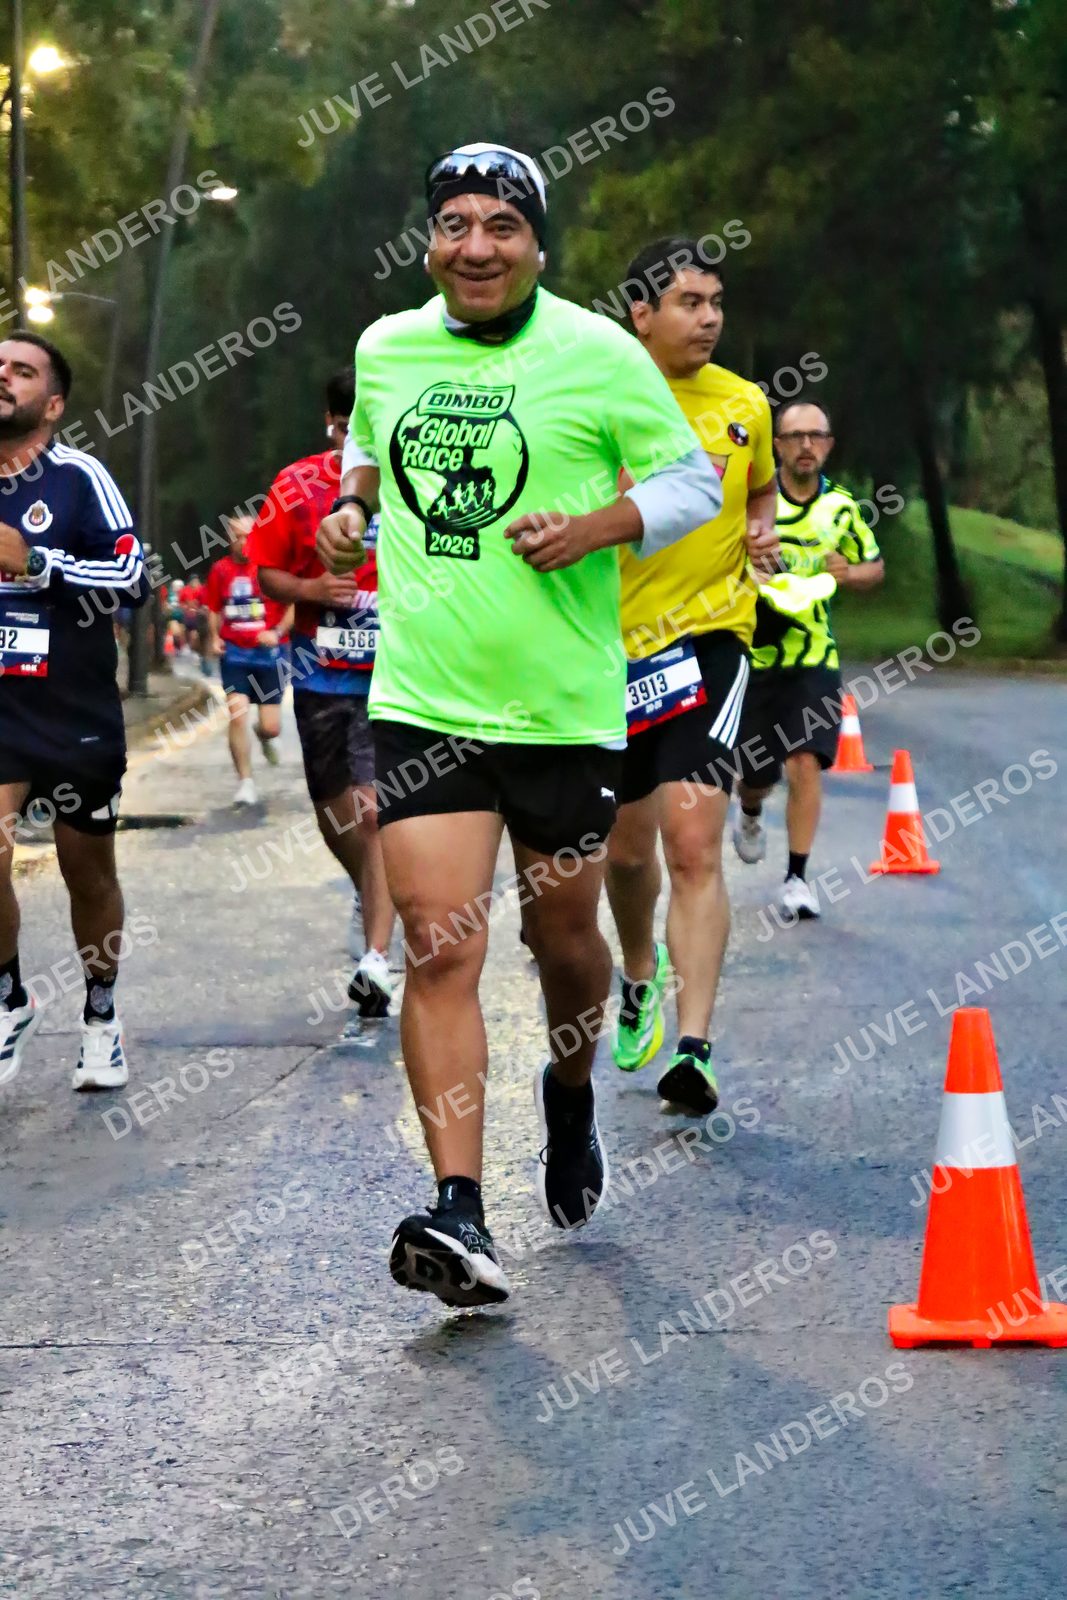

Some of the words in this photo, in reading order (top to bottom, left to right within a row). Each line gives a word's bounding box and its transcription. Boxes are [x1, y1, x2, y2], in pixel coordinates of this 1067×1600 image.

[427, 392, 504, 410] BIMBO
[419, 417, 496, 448] Global
[402, 439, 464, 472] Race
[429, 532, 475, 555] 2026
[628, 672, 668, 706] 3913
